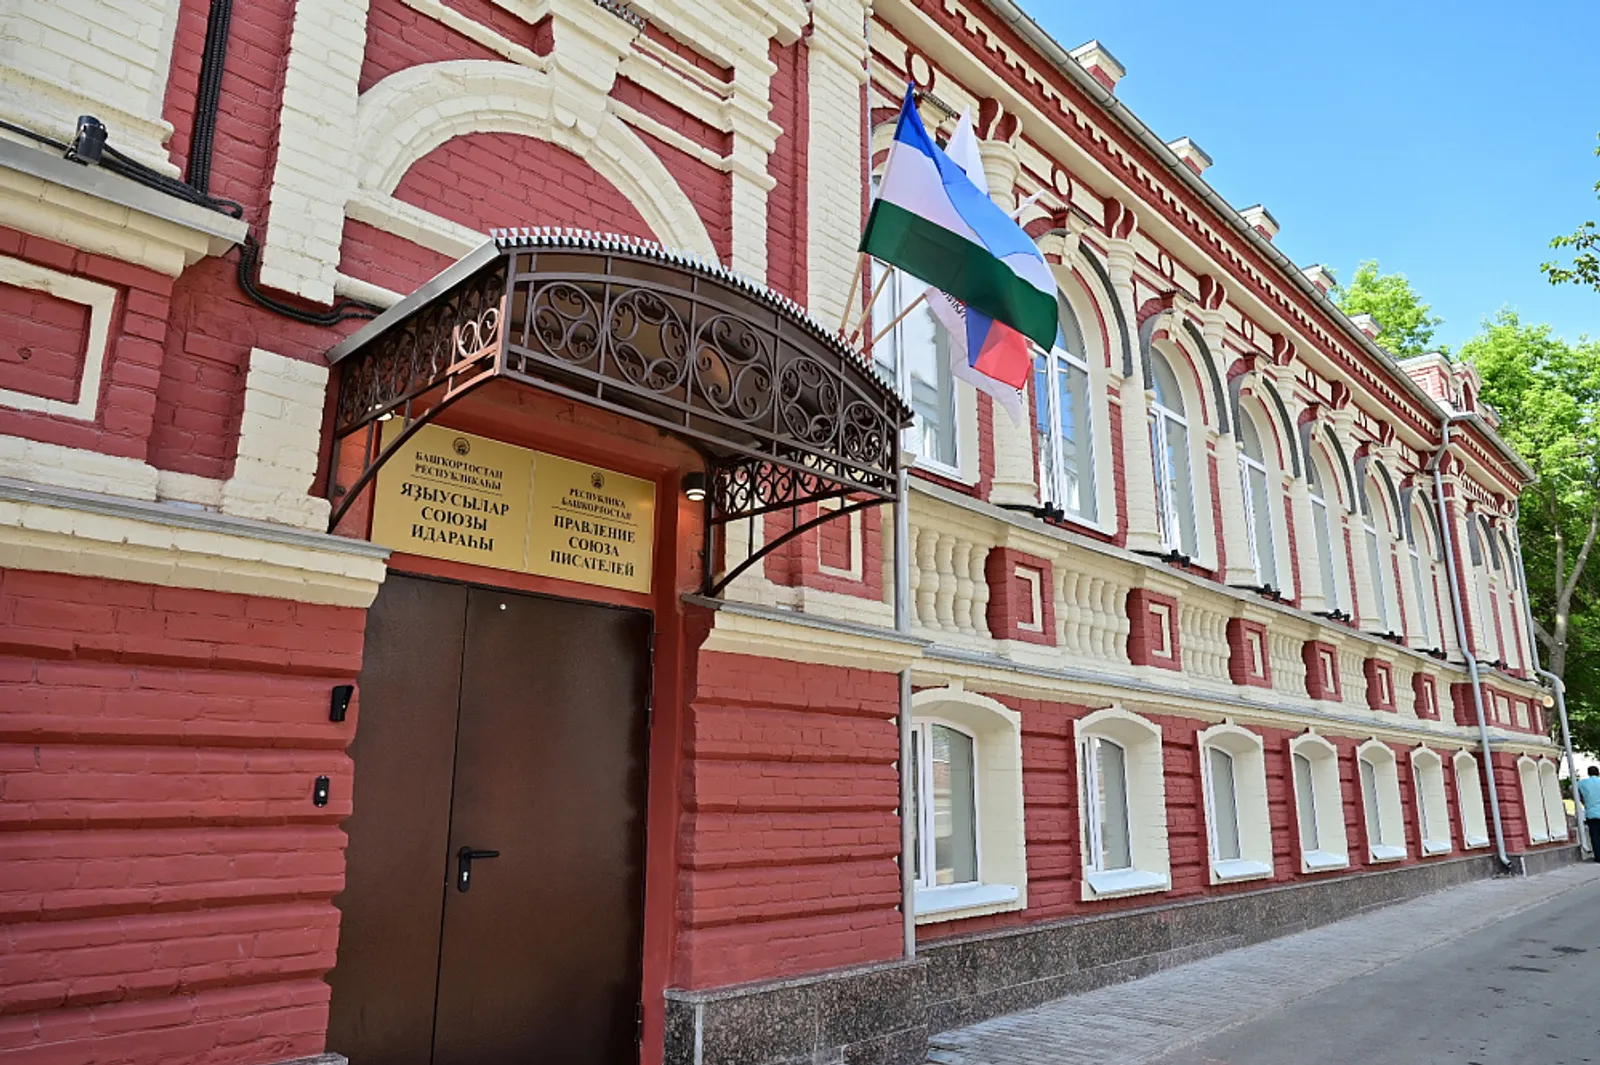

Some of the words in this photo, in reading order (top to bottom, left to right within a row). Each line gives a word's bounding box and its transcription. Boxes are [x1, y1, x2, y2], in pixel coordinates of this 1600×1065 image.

[400, 482, 510, 516] ЯҘЫУСЫЛАР
[562, 496, 632, 520] БАШКОРТОСТАН
[569, 488, 626, 508] РЕСПУБЛИКА
[421, 506, 488, 531] СОЮЗЫ
[554, 514, 636, 544] ПРАВЛЕНИЕ
[412, 524, 494, 552] ИДАРАҺЫ
[568, 536, 620, 557] СОЮЗА
[550, 549, 634, 577] ПИСАТЕЛЕЙ
